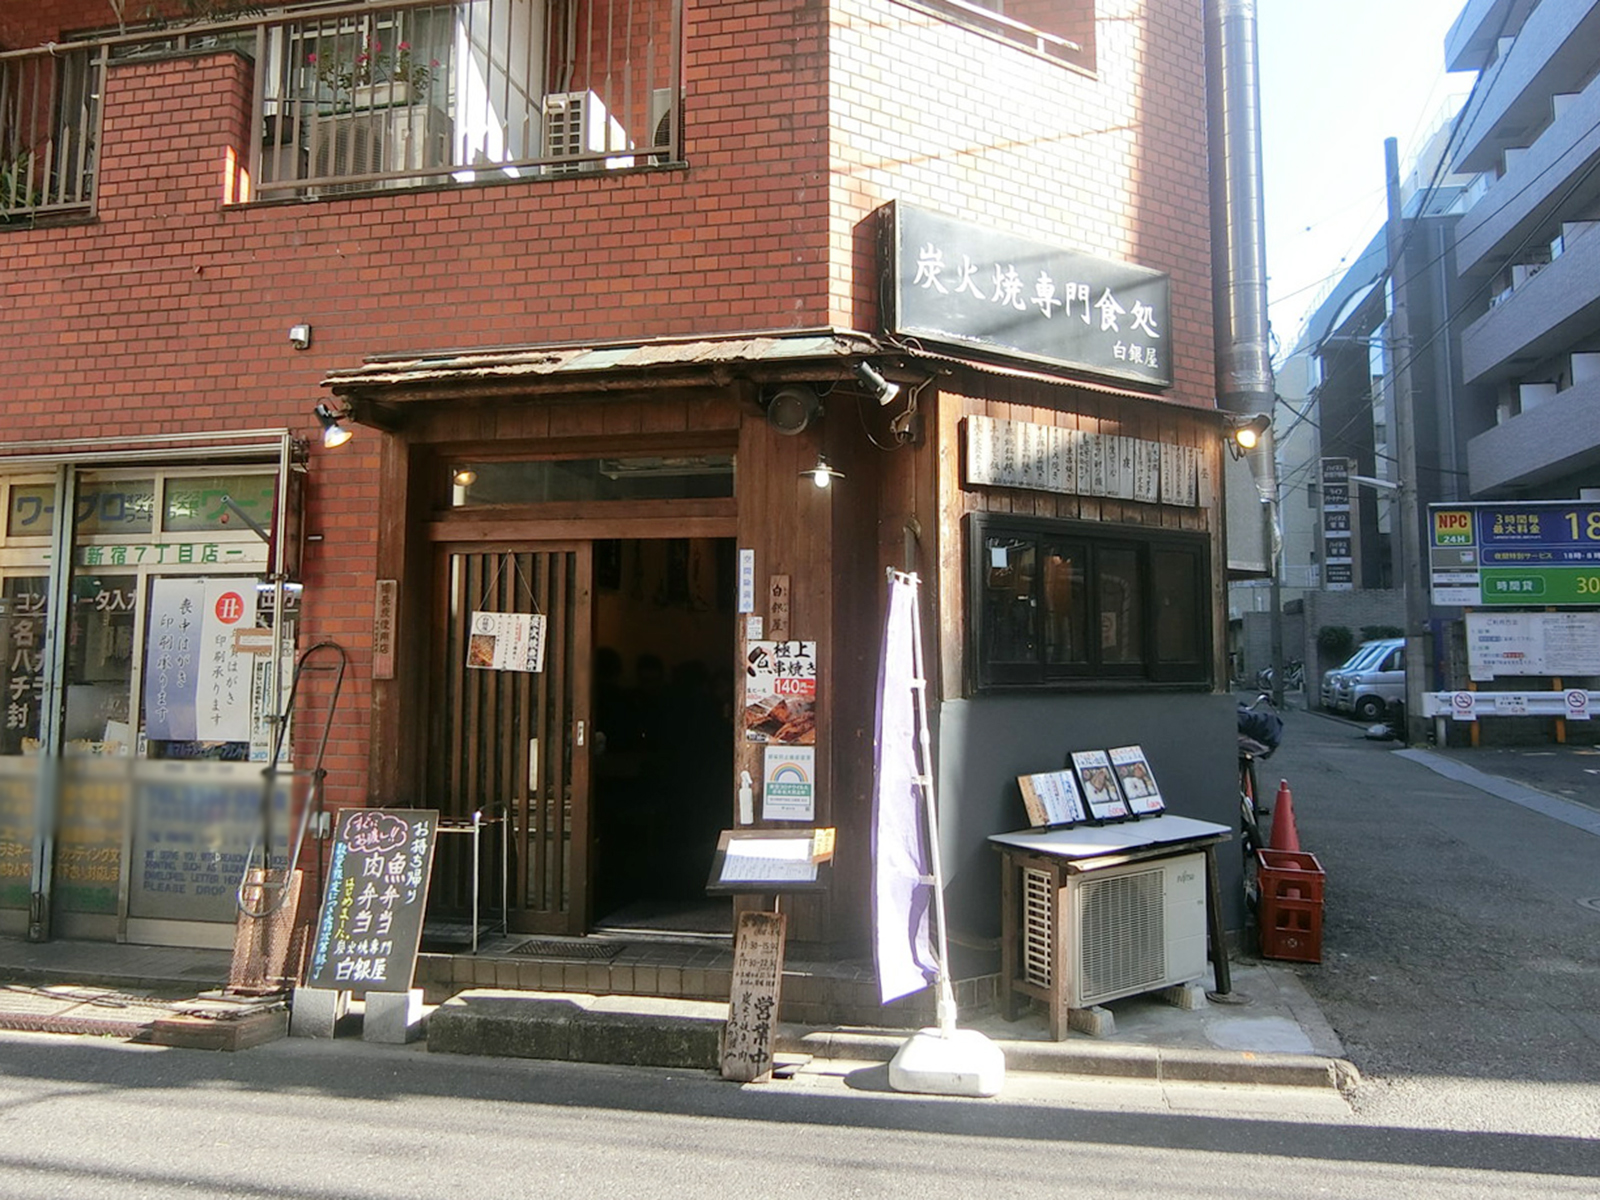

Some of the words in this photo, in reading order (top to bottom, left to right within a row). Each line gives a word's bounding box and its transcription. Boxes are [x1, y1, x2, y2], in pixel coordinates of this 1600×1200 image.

[913, 241, 1160, 340] 炭火焼専門食処
[1111, 340, 1159, 370] 白銀屋
[1438, 514, 1468, 529] NPC
[1493, 524, 1541, 534] 最大料金
[1443, 535, 1466, 543] 24H
[1496, 580, 1533, 592] 時間貸
[219, 597, 239, 620] 丑
[176, 597, 193, 690] 喪中はがき
[773, 641, 811, 659] 極上
[157, 613, 175, 725] 印刷承ります
[211, 634, 227, 726] 印刷承ります
[773, 660, 816, 678] 串焼き
[405, 820, 429, 906] お持ち帰り
[195, 885, 227, 896] DROP
[352, 852, 385, 934] 肉弁当
[377, 852, 407, 935] 魚弁当
[335, 956, 388, 981] 白銀屋
[749, 995, 775, 1077] 営業中
